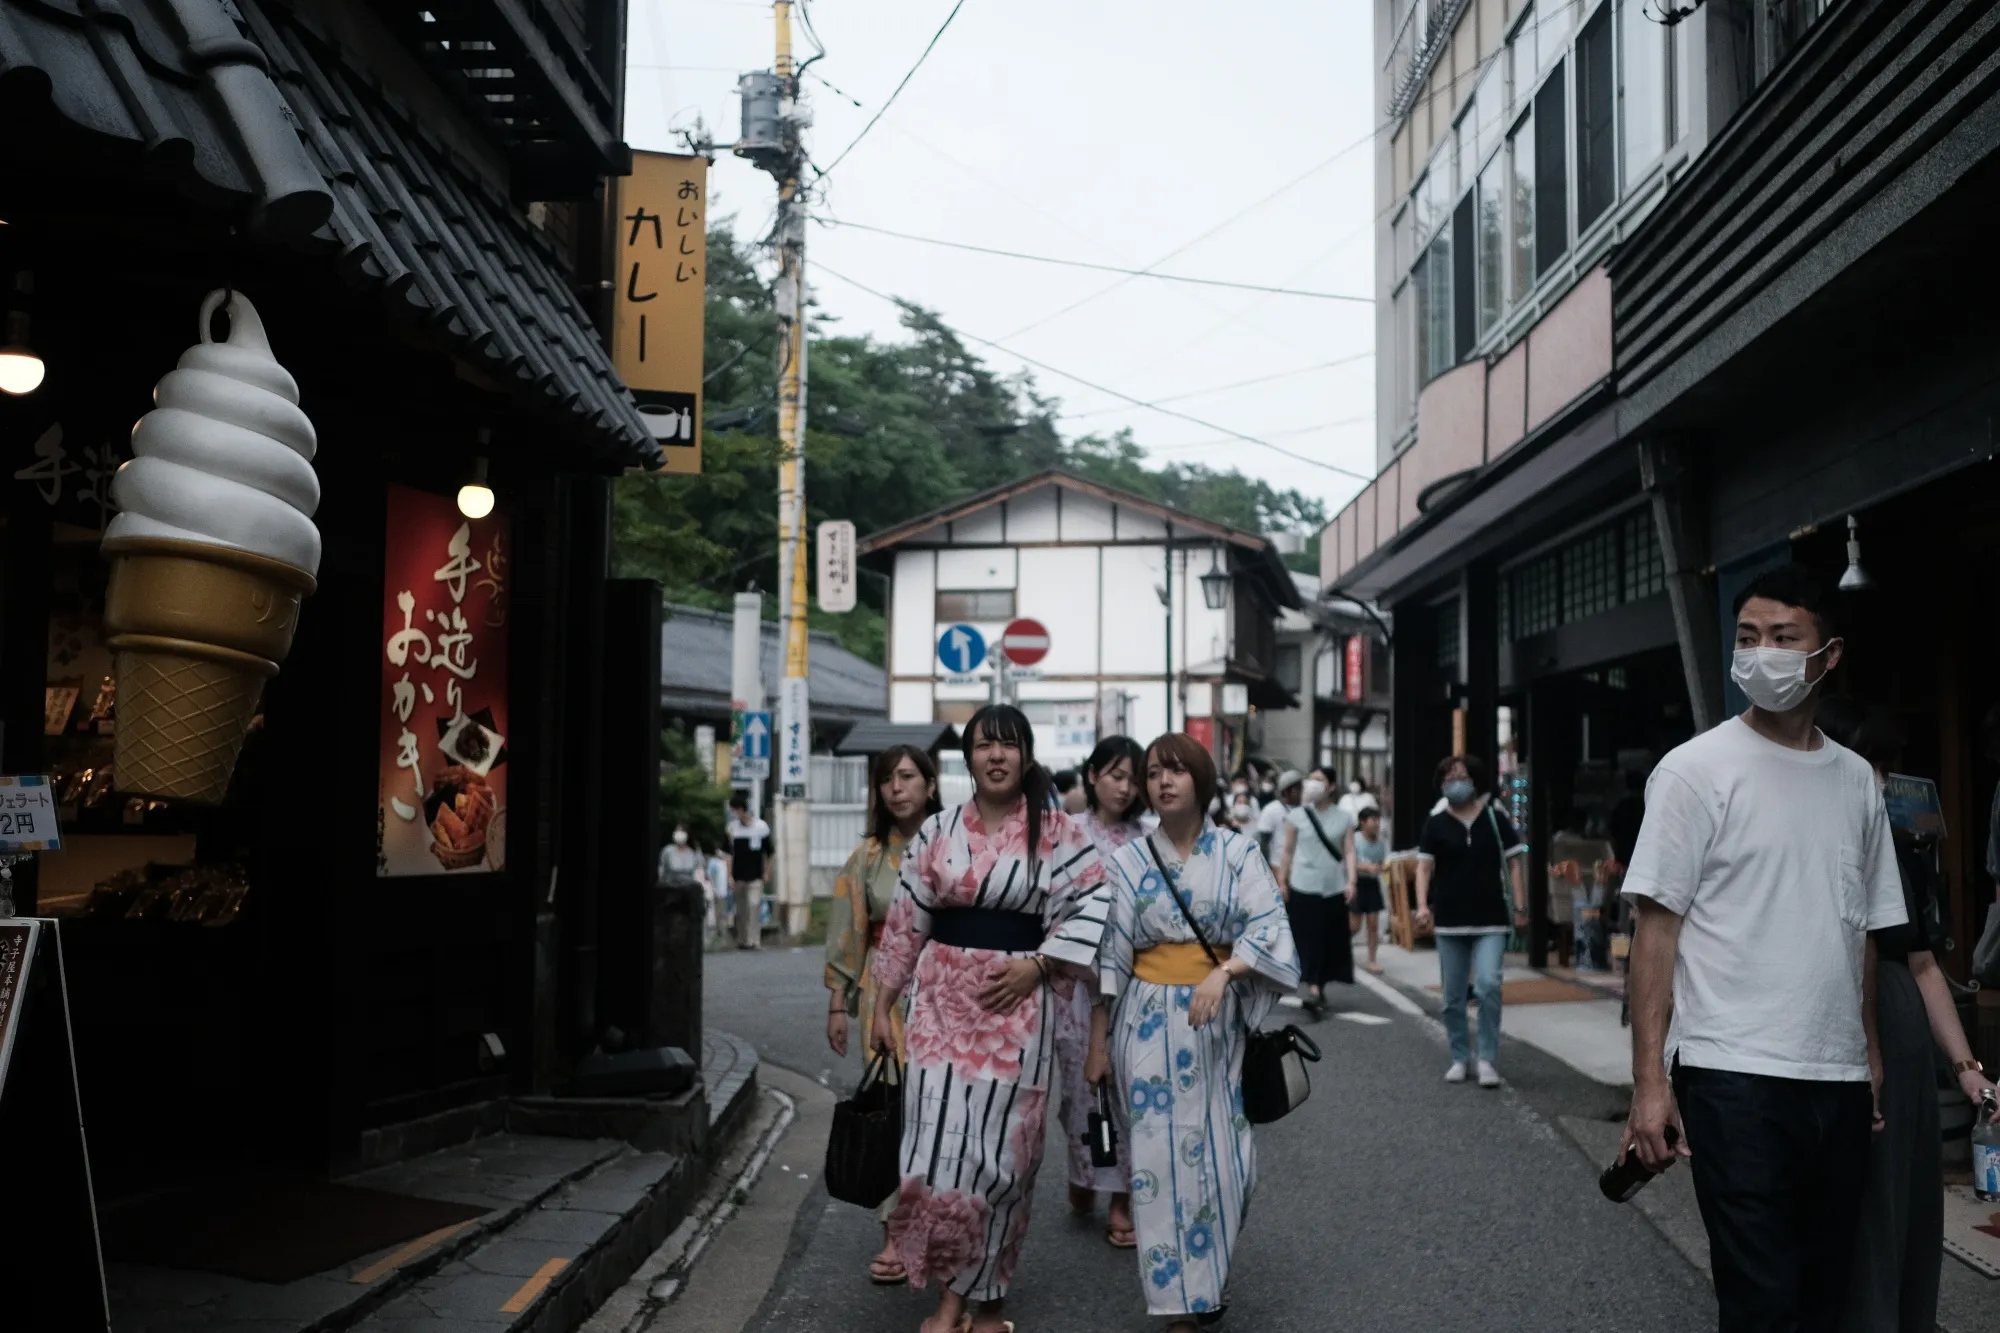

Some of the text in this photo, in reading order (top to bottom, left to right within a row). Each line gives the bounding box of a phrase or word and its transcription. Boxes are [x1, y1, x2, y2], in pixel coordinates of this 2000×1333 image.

[626, 207, 662, 362] カレー
[676, 180, 698, 282] おいしい
[386, 590, 435, 821] おかき
[433, 521, 481, 726] 手造り
